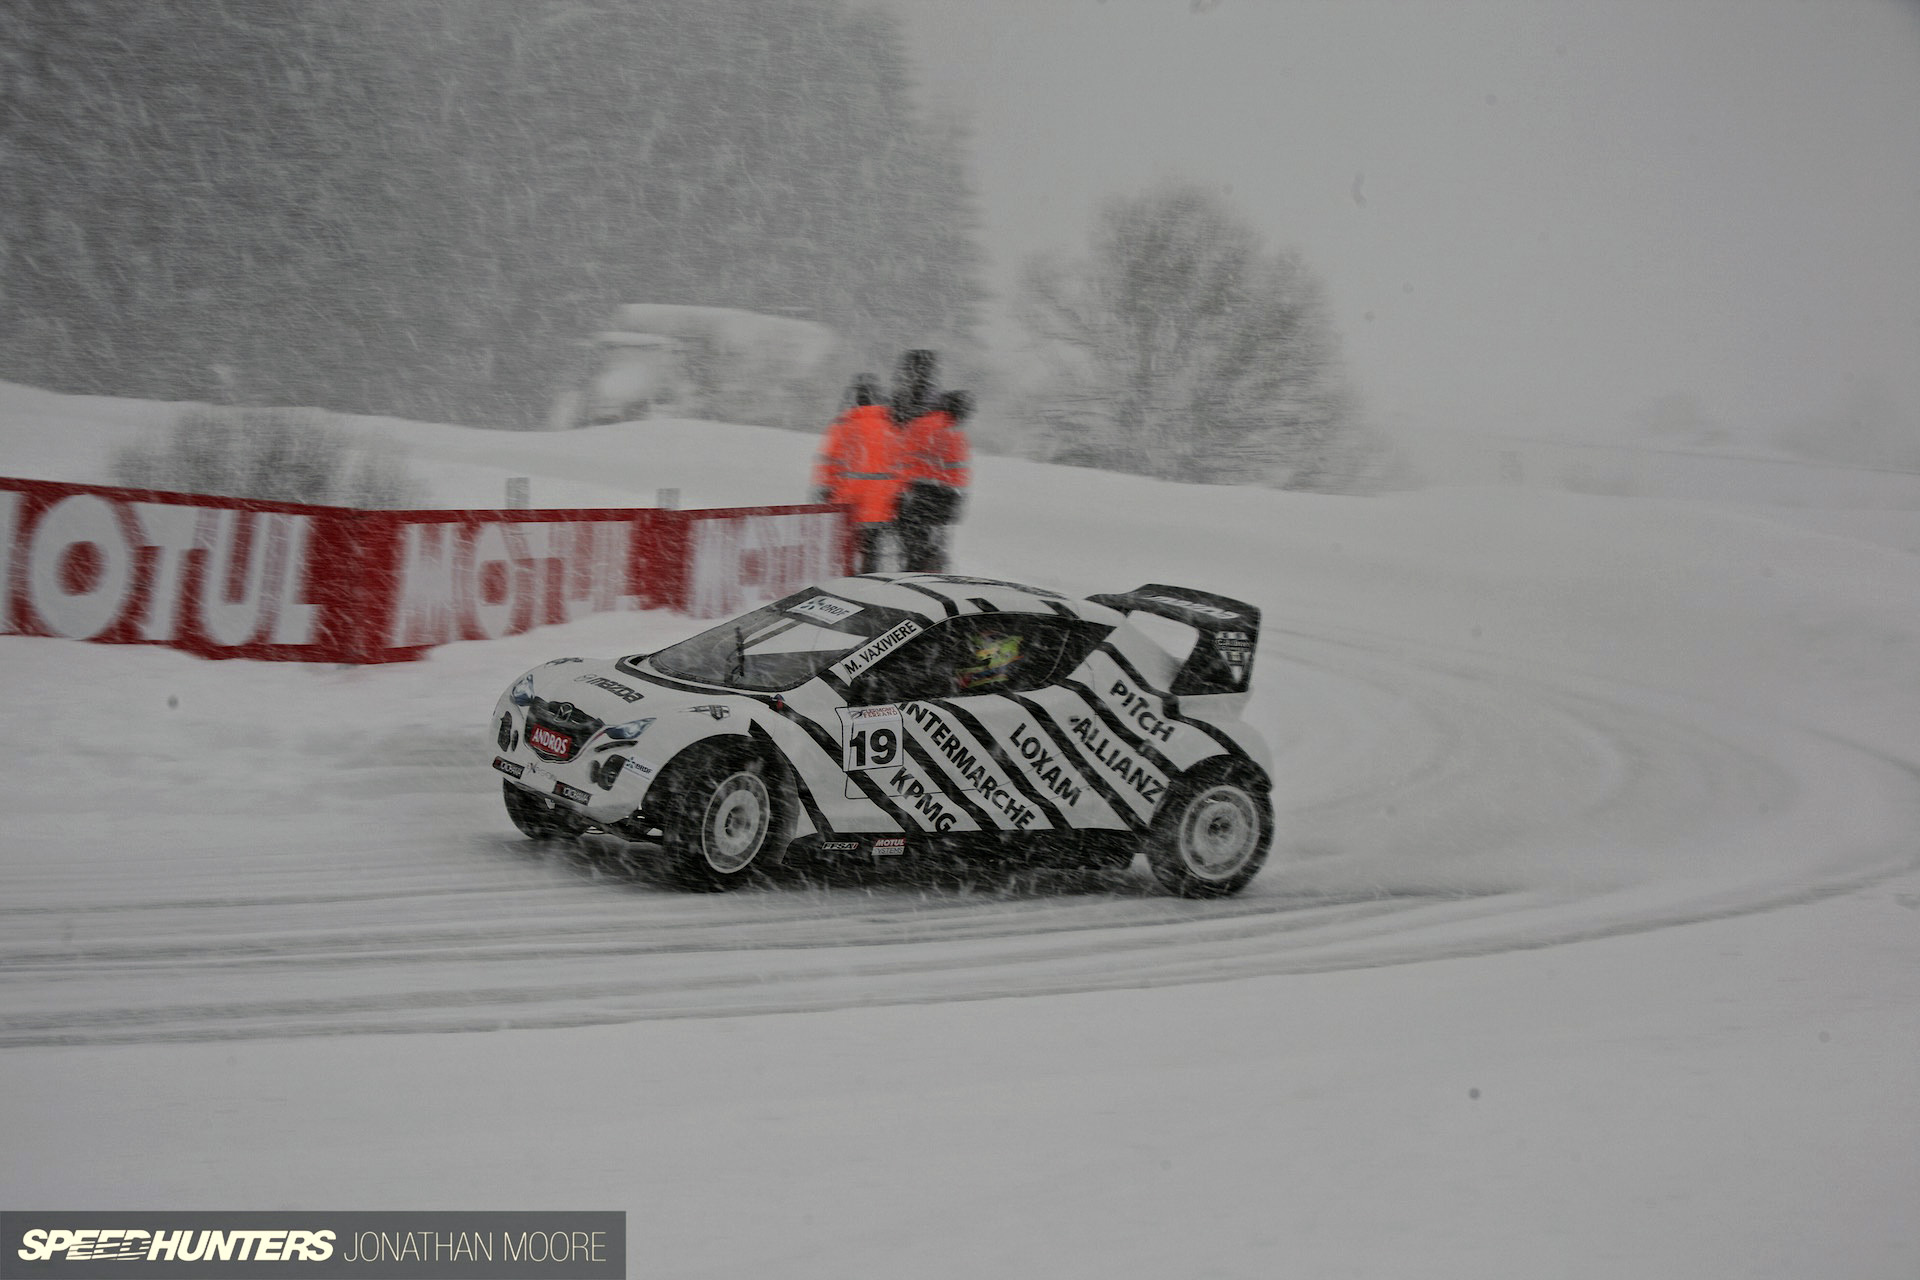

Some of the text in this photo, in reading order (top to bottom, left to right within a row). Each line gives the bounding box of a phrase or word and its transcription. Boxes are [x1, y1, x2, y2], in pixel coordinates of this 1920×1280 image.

[0, 492, 323, 648] OTUL
[844, 620, 918, 675] M. VAXIVIERE
[532, 727, 569, 754] ANDROS
[1110, 679, 1175, 742] PITCH
[849, 728, 897, 767] 19
[897, 701, 1036, 831] INTERMARCHE
[1009, 722, 1082, 807] LOXAM
[1072, 717, 1167, 804] ALLIANZ
[889, 766, 958, 833] KPMG
[875, 838, 905, 847] MOTUL
